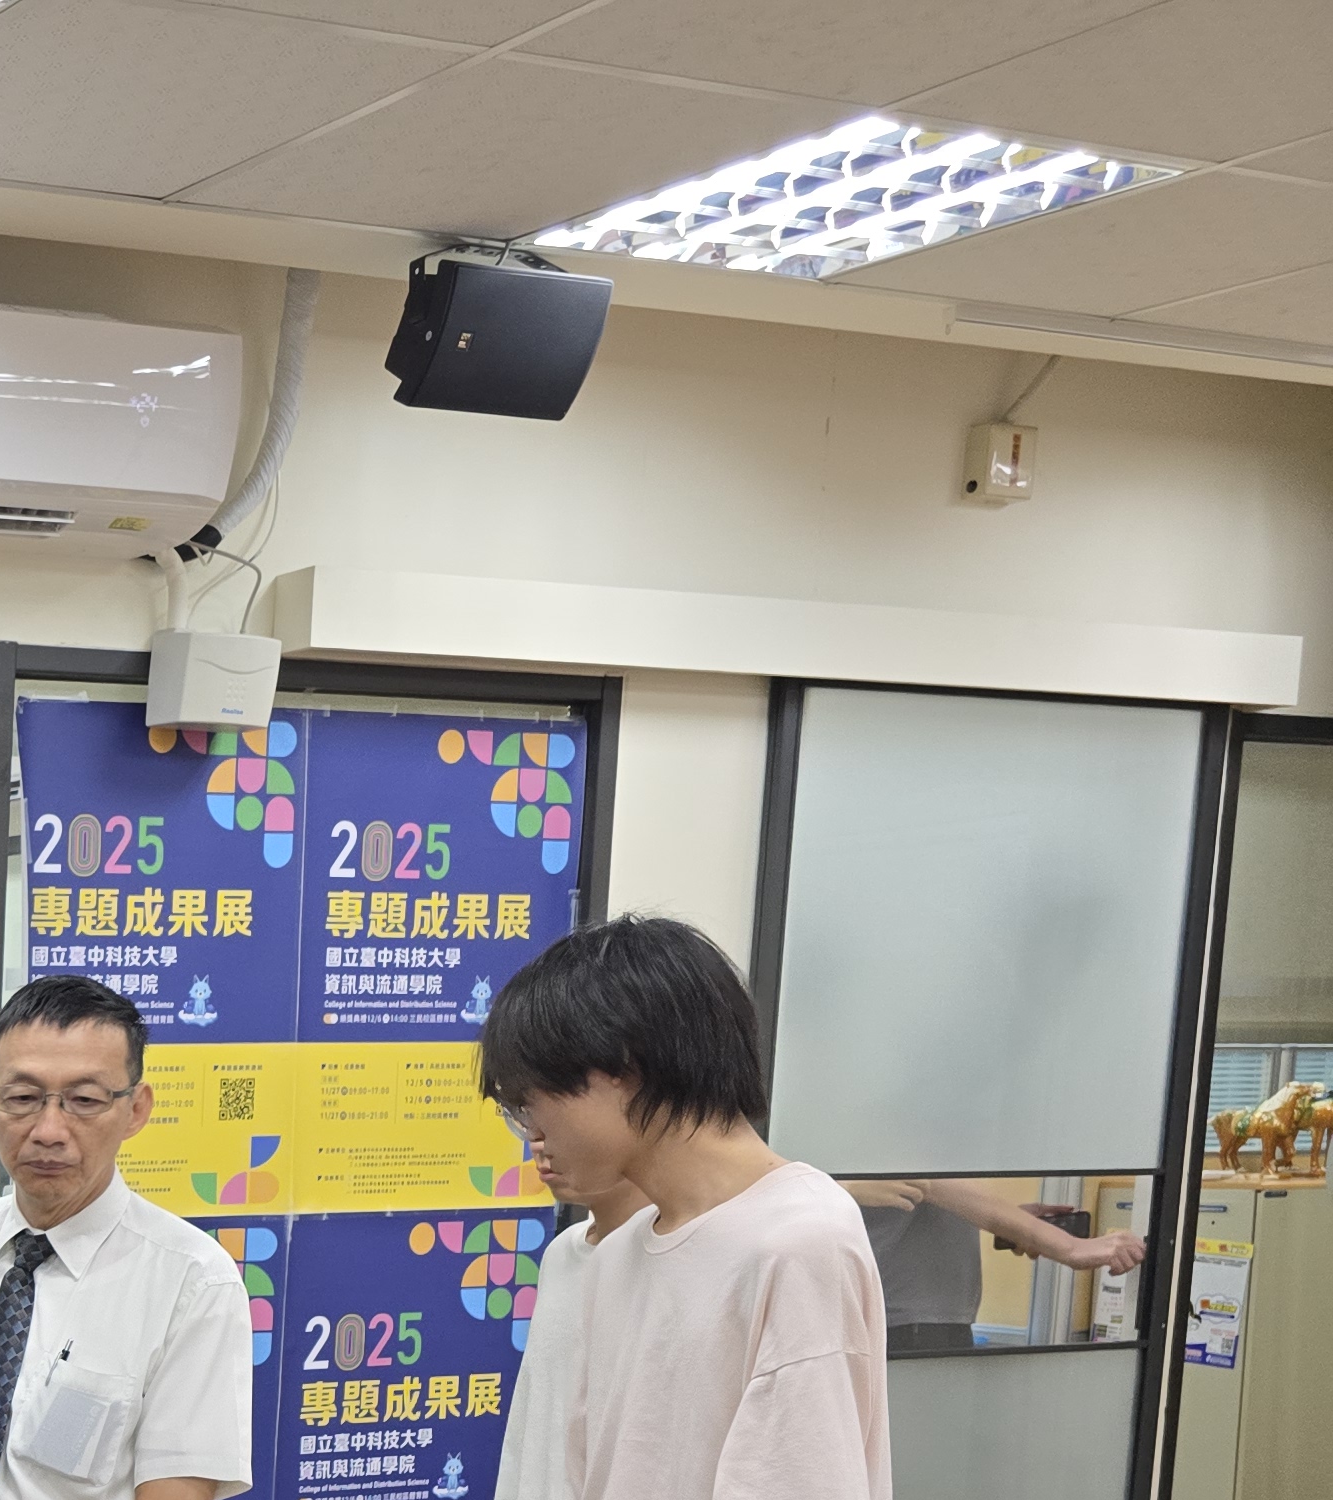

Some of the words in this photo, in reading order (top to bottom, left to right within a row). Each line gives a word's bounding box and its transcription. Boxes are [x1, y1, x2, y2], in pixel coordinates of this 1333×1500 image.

[33, 813, 165, 878] 2025
[329, 820, 451, 882] 2025
[30, 887, 254, 938] 專題成果展
[325, 890, 531, 942] 專題成果展
[31, 945, 178, 967] 國立臺中科技大學
[326, 946, 461, 968] 國立臺中科技大學
[324, 974, 443, 995] 資訊與流通學院
[303, 1312, 423, 1372] 2025
[299, 1372, 502, 1427] 專題成果展
[300, 1427, 433, 1455] 國立臺中科技大學
[298, 1454, 416, 1481] 資訊與流通學院
